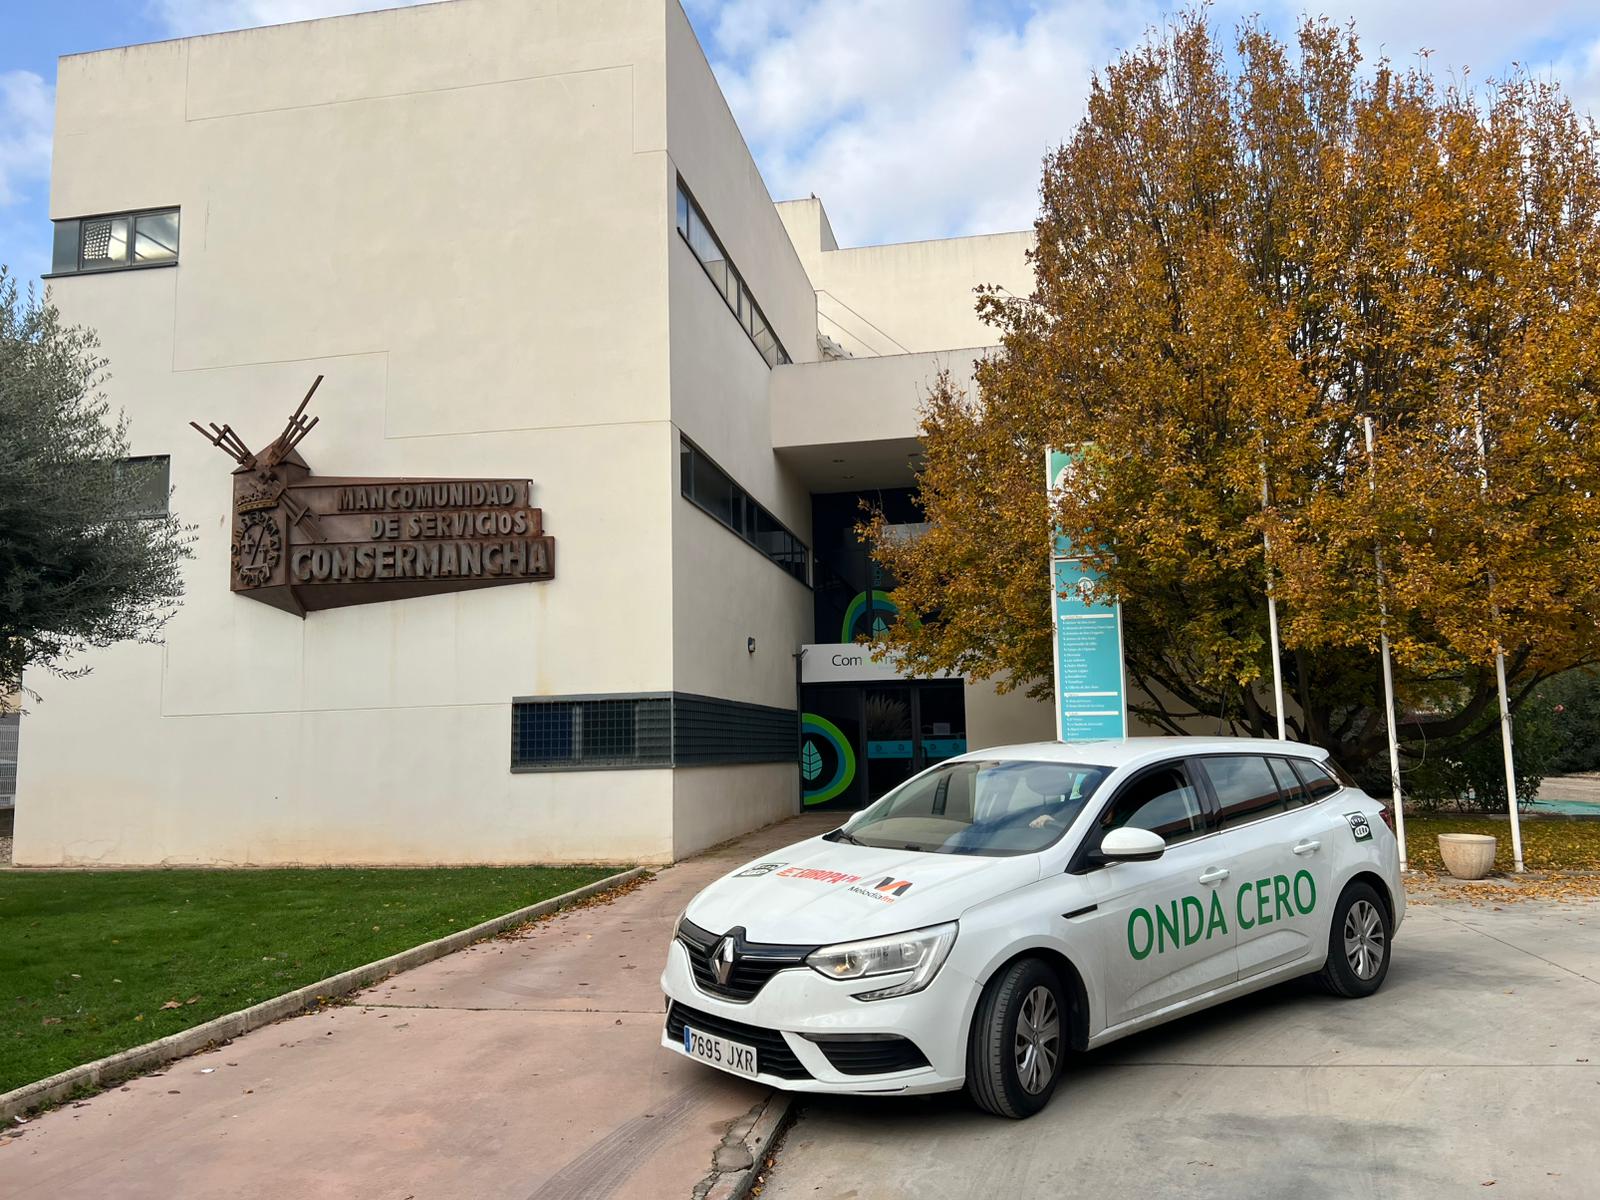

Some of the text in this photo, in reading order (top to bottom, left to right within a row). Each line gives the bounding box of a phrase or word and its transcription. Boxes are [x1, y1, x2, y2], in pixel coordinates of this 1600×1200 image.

[337, 484, 515, 512] MANCOMUNIDAD
[370, 510, 529, 539] DE SERVICIOS
[291, 541, 550, 582] COMSERMANCHA
[1127, 869, 1317, 961] ONDA CERO
[691, 1032, 754, 1073] 7695 JXR
